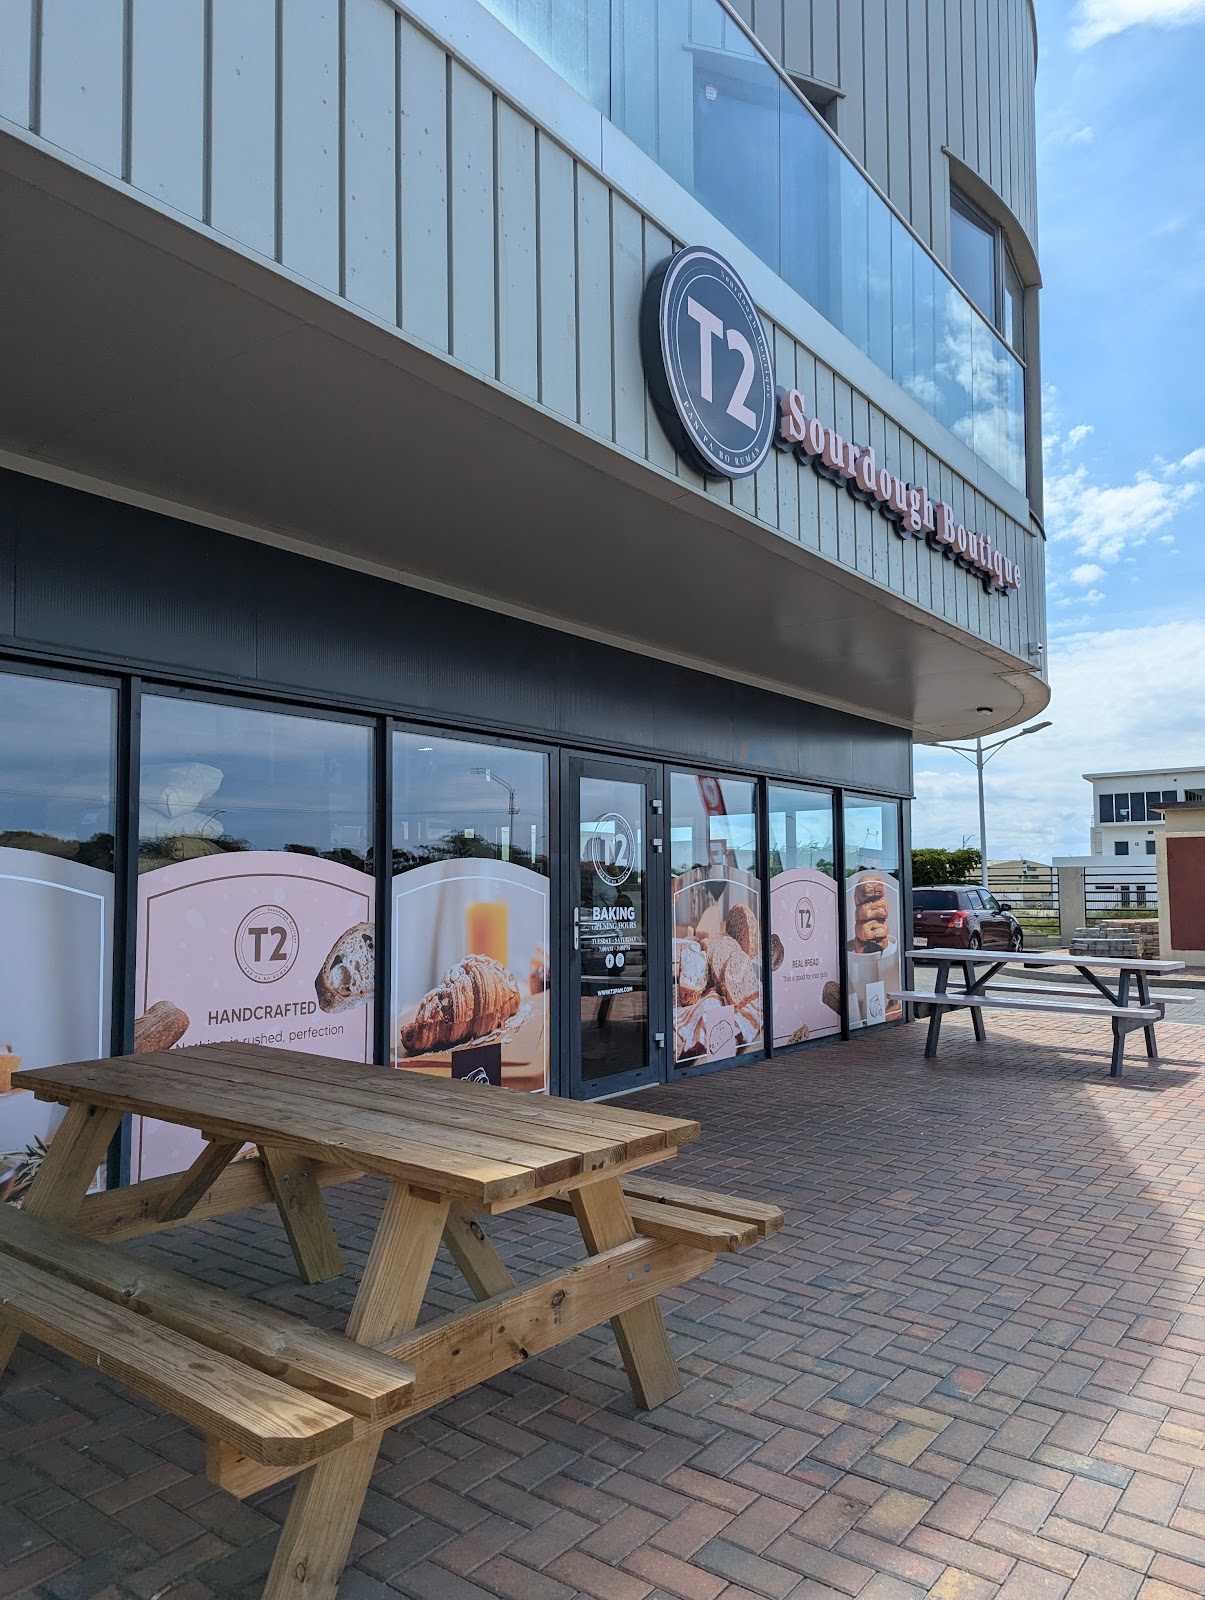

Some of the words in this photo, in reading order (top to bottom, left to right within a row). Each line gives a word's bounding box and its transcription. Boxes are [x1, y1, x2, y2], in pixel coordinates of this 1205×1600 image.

[720, 269, 758, 329] Sourdough
[757, 335, 771, 399] Boutique
[687, 295, 757, 432] T2
[683, 400, 700, 431] PAN
[703, 434, 714, 452] PA
[719, 450, 730, 463] BO
[734, 445, 760, 466] RUMAN
[782, 388, 935, 533] Sourdough
[936, 501, 1022, 590] Boutique
[601, 833, 628, 867] T2
[591, 922, 617, 931] OPENING
[618, 921, 637, 930] HOURS
[592, 906, 636, 921] BAKING
[799, 909, 812, 928] T2
[248, 926, 288, 962] T2
[591, 937, 611, 945] TUESDAY
[792, 960, 803, 968] REAL
[805, 959, 819, 967] BREAD
[208, 1000, 317, 1026] HANDCRAFTED
[243, 1030, 285, 1045] rushed,
[288, 1024, 345, 1044] perfection
